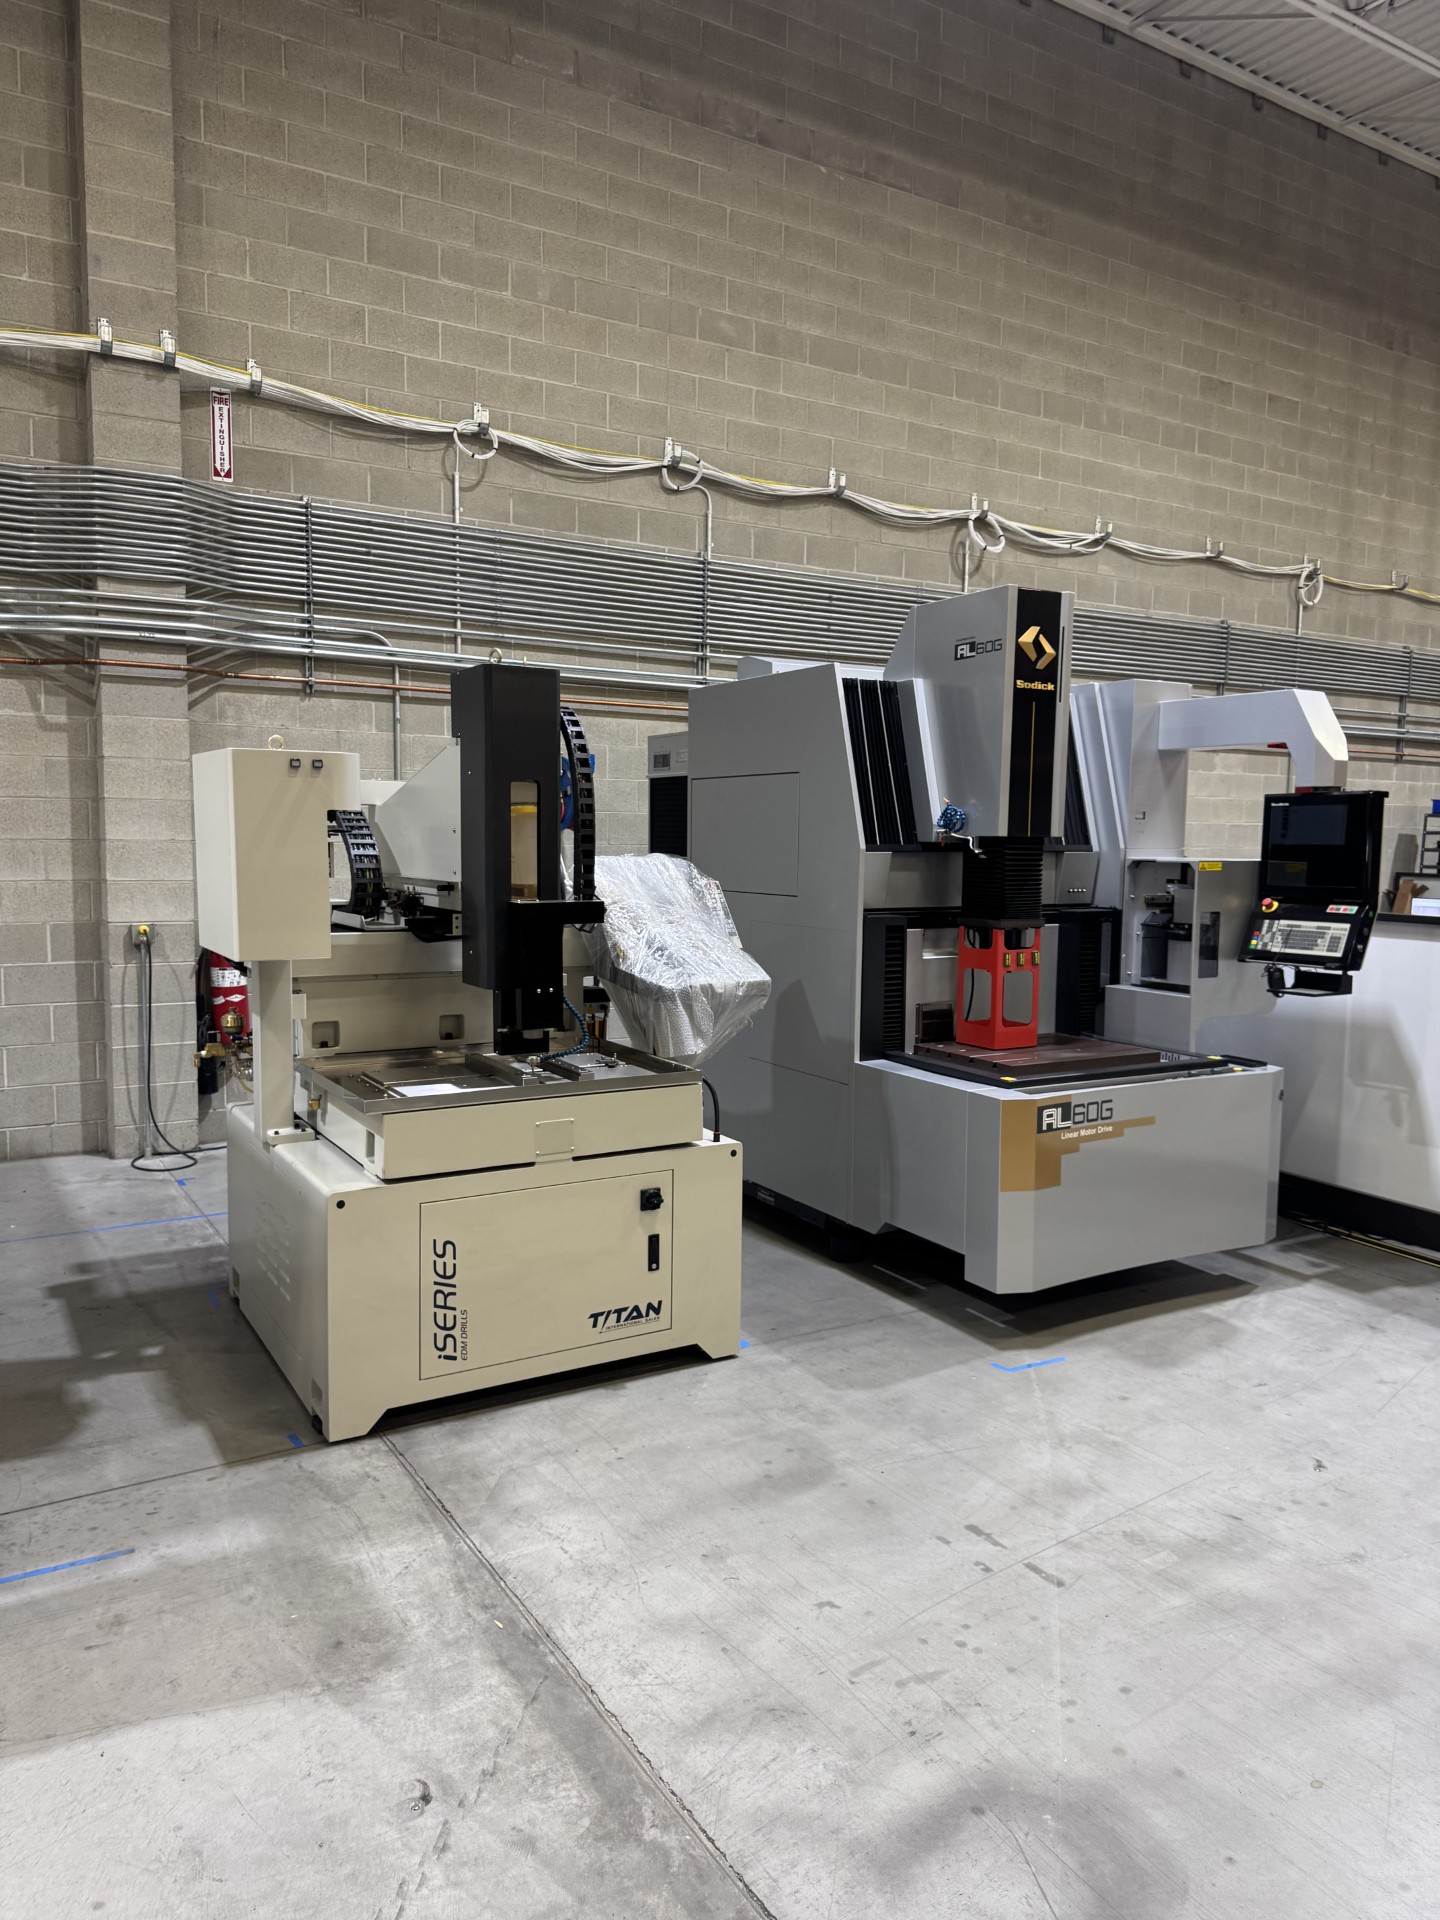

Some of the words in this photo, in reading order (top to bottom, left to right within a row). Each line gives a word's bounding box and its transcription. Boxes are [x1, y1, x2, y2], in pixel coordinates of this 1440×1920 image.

[213, 396, 229, 406] FIRE
[218, 406, 226, 473] EXTINGUISHER
[956, 638, 1003, 659] AL60G
[1015, 679, 1055, 691] Sodick
[1041, 1099, 1114, 1131] AL60G
[1061, 1130, 1079, 1140] Linear
[1079, 1127, 1097, 1137] Motor
[1097, 1124, 1113, 1133] Drive
[432, 1238, 458, 1361] iSERIES
[460, 1309, 468, 1339] DRILLS
[587, 1299, 663, 1330] TITAN
[460, 1341, 468, 1361] EDM
